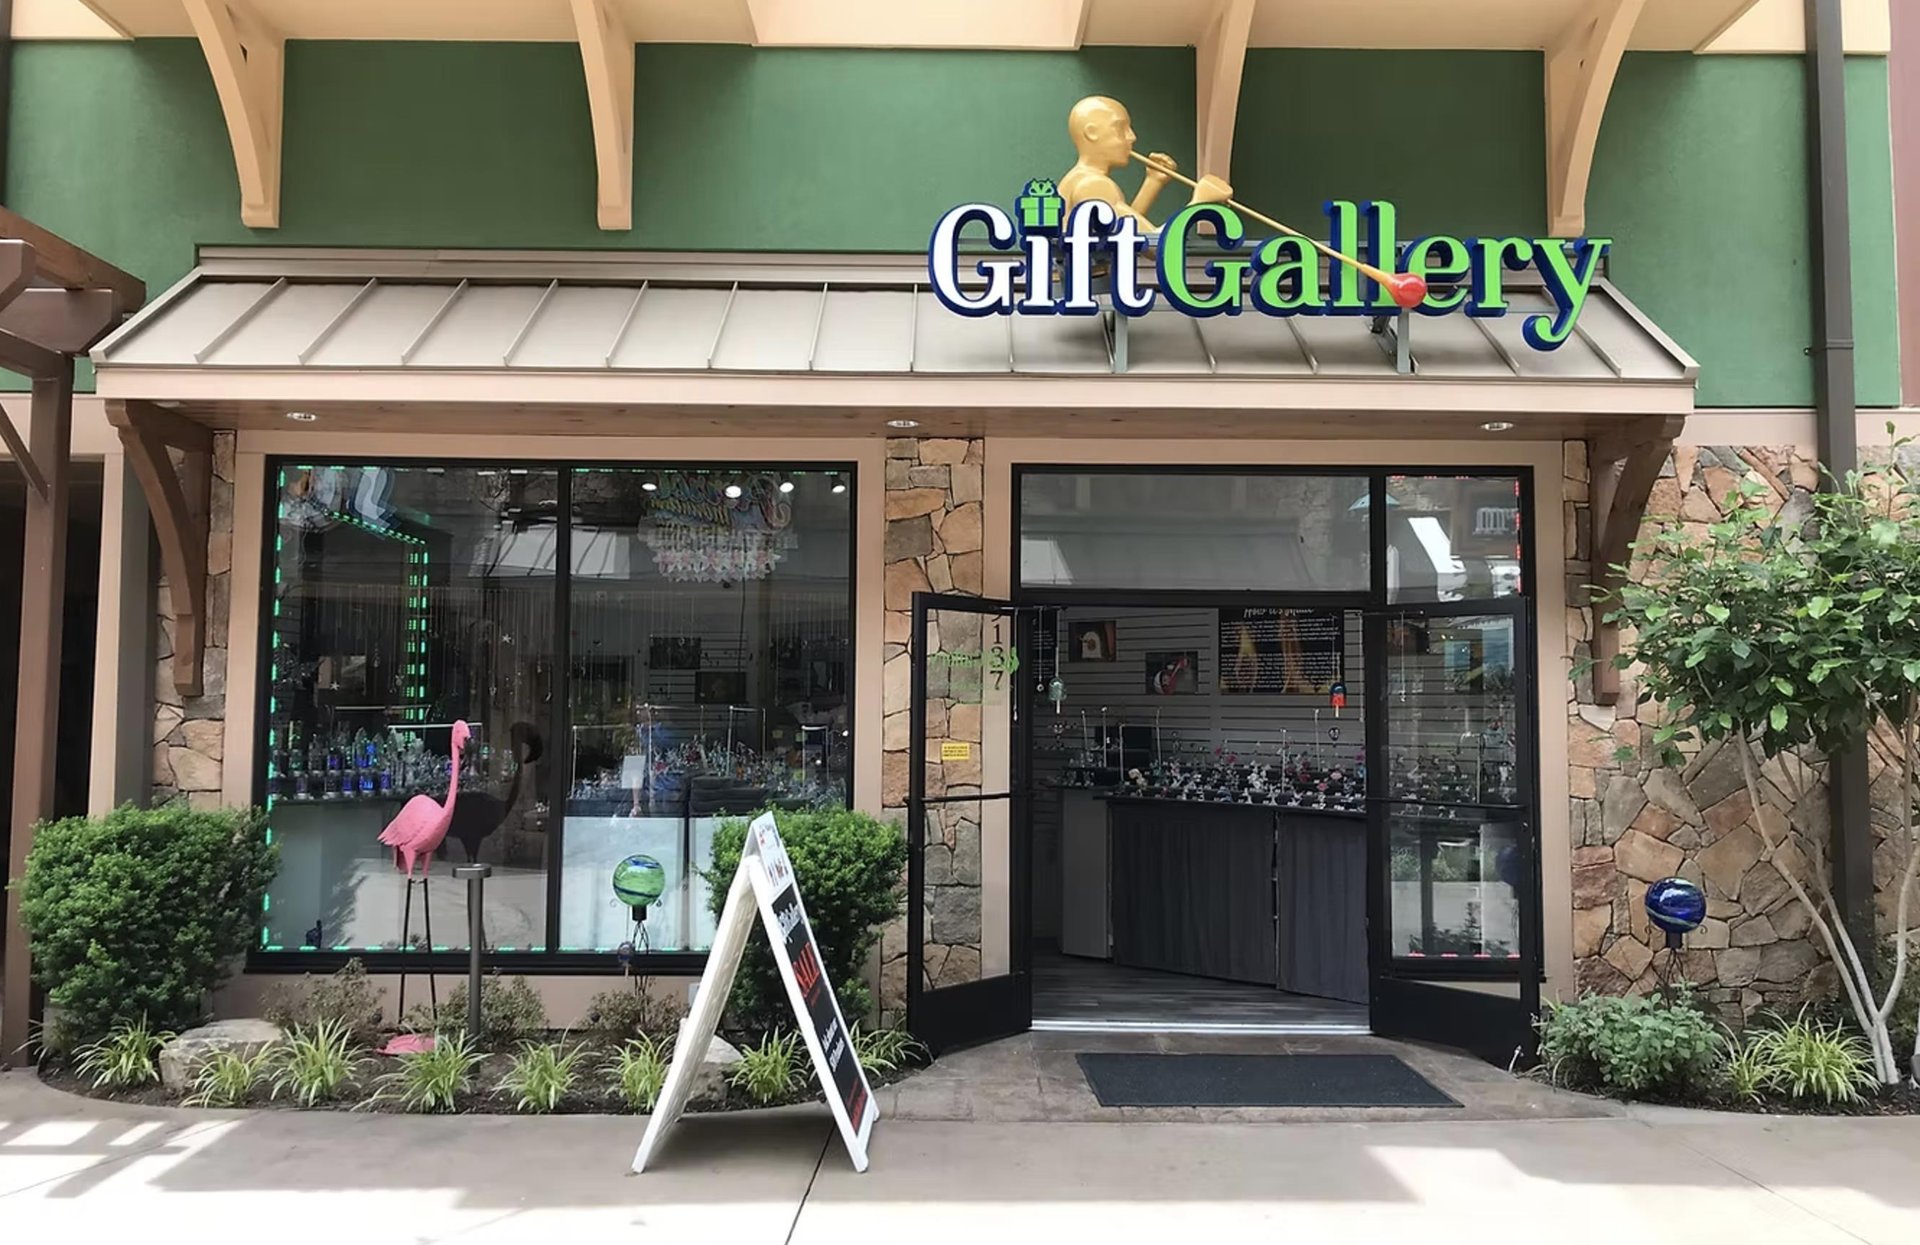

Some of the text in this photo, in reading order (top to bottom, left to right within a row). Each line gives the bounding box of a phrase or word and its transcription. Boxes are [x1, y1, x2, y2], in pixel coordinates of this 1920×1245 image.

[928, 198, 1612, 353] Gift Gallery
[990, 624, 1005, 690] 137
